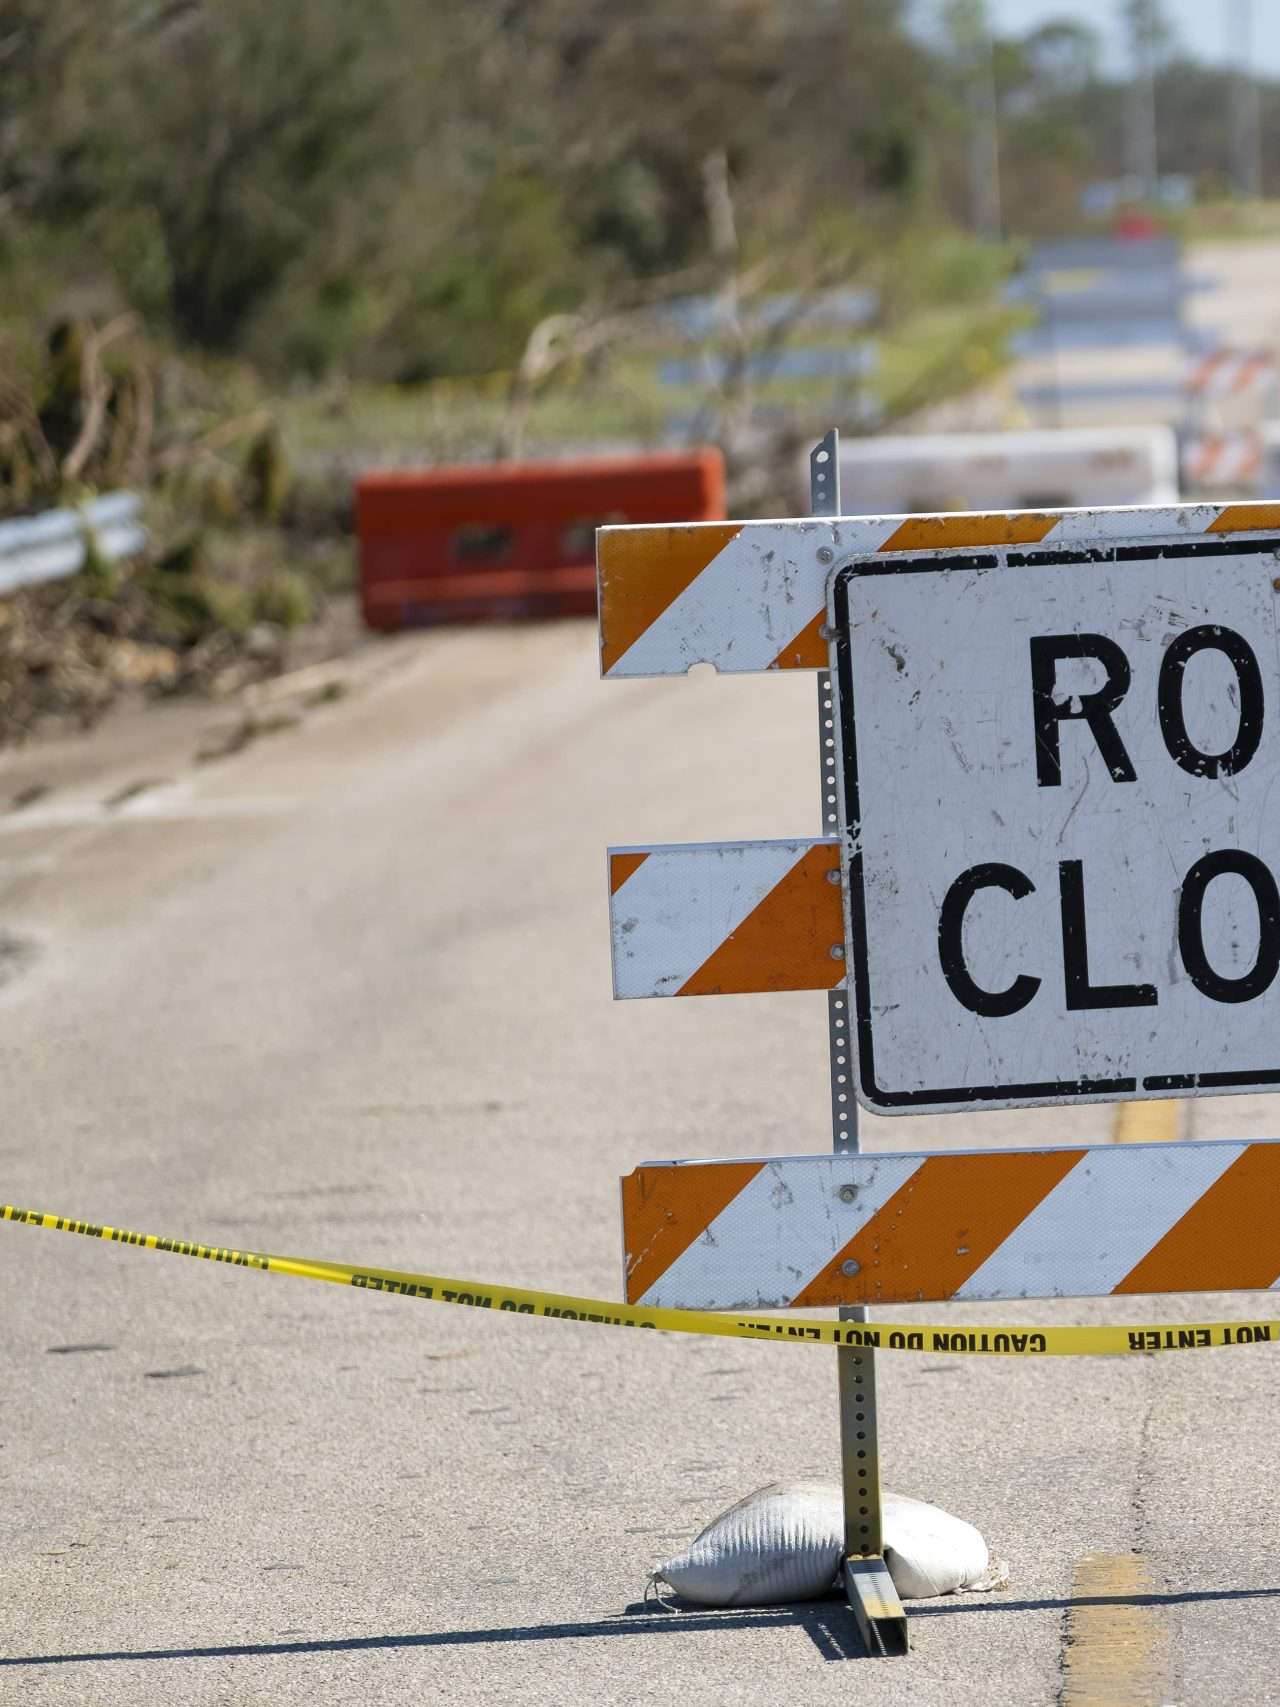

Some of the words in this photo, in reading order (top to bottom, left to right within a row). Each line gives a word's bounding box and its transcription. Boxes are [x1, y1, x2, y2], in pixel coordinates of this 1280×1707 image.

[932, 1333, 1047, 1353] CAUTION
[1127, 1328, 1211, 1351] ENTER
[1222, 1325, 1271, 1346] NOT
